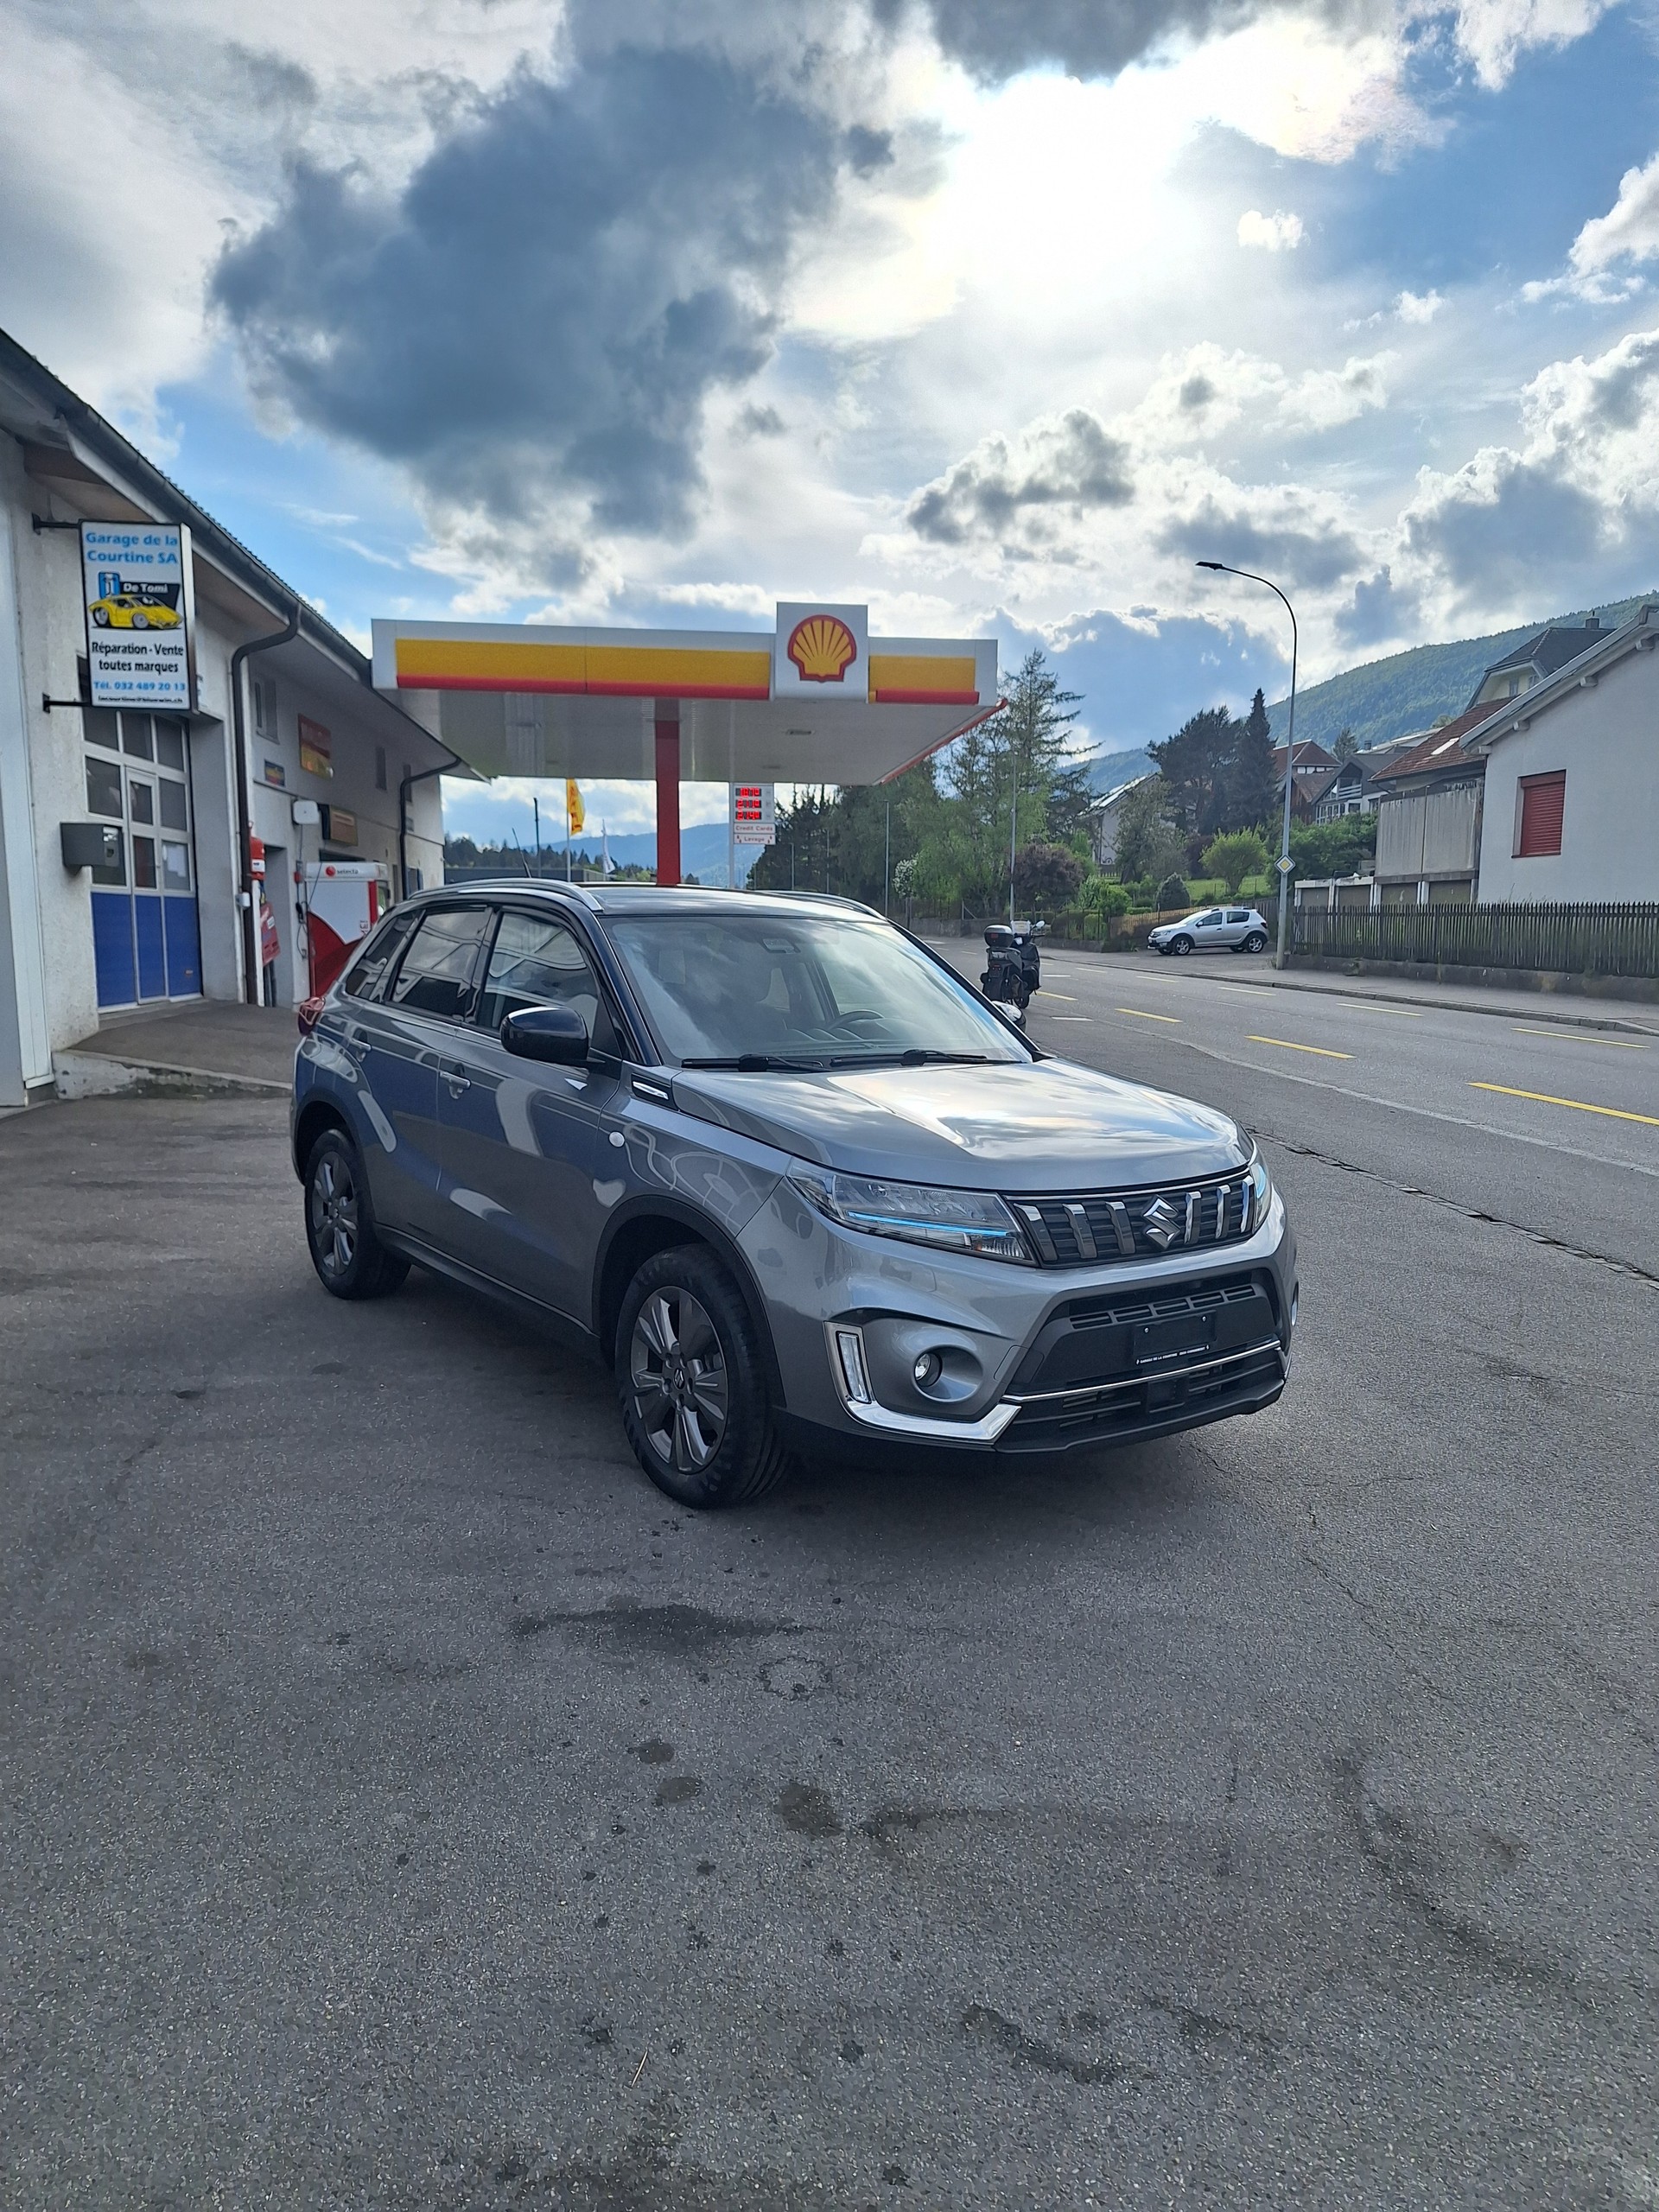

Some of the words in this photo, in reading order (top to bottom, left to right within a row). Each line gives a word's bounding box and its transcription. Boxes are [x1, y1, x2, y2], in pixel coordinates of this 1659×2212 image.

[86, 531, 139, 547] Garage
[143, 534, 161, 545] de
[165, 535, 178, 546] la
[87, 550, 154, 563] Courtine
[158, 551, 178, 564] SA
[123, 582, 139, 593] De
[92, 641, 148, 657] Réparation
[154, 643, 184, 656] Vente
[99, 659, 131, 671] toutes
[134, 662, 179, 675] marques
[114, 681, 134, 690] 032
[136, 682, 155, 690] 489
[157, 682, 171, 690] 20
[174, 682, 186, 690] 13
